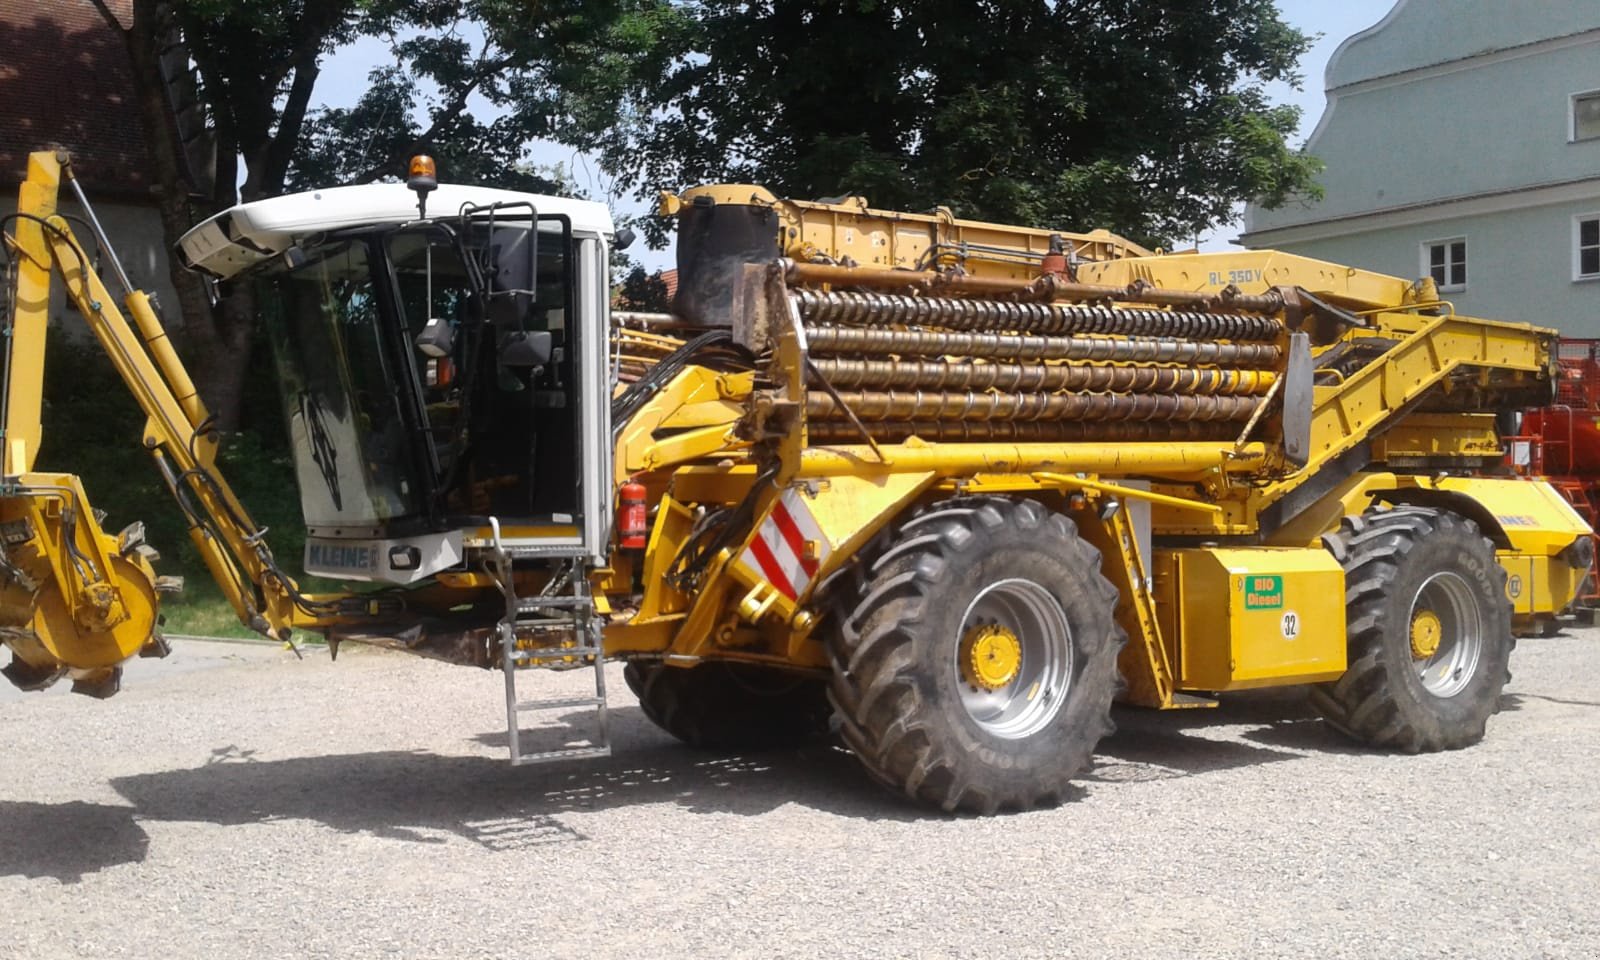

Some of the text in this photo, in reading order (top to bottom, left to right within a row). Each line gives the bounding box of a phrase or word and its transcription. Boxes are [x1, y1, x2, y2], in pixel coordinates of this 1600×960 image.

[1209, 271, 1226, 285] RL
[310, 544, 369, 569] KLEINE
[1254, 578, 1275, 592] BIO
[1247, 592, 1281, 607] Diesel
[1284, 614, 1297, 636] 32
